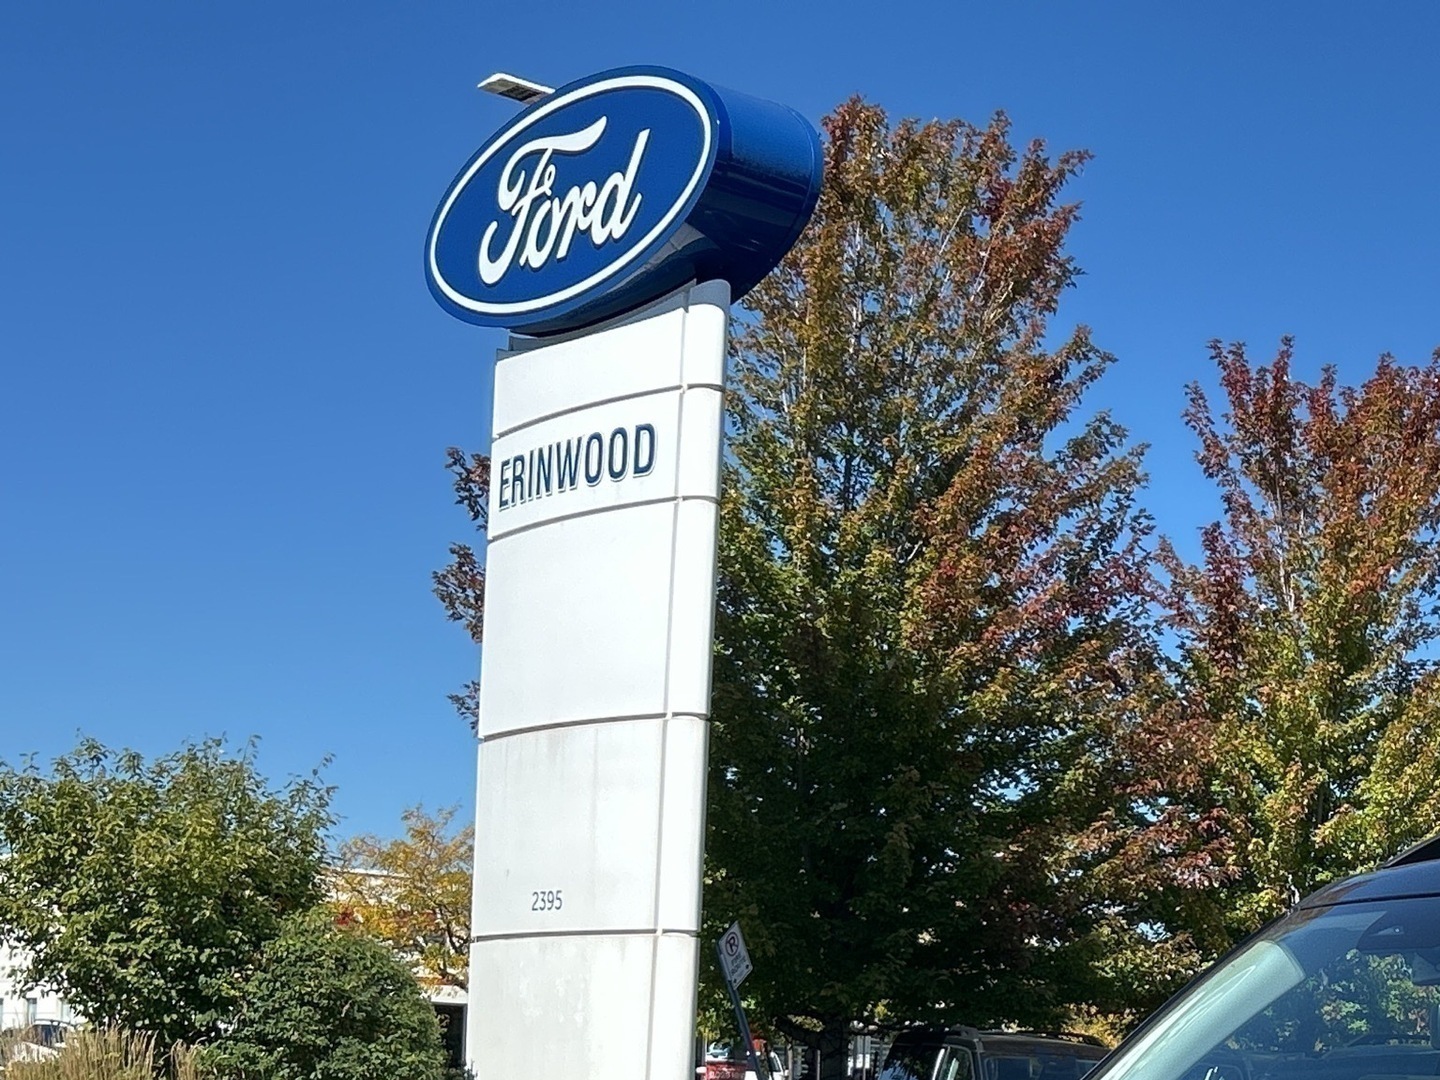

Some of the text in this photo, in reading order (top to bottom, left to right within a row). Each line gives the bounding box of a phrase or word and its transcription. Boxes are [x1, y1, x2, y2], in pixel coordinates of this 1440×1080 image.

[478, 115, 650, 286] Ford
[499, 422, 659, 511] ERINWOOD
[531, 890, 563, 911] 2395
